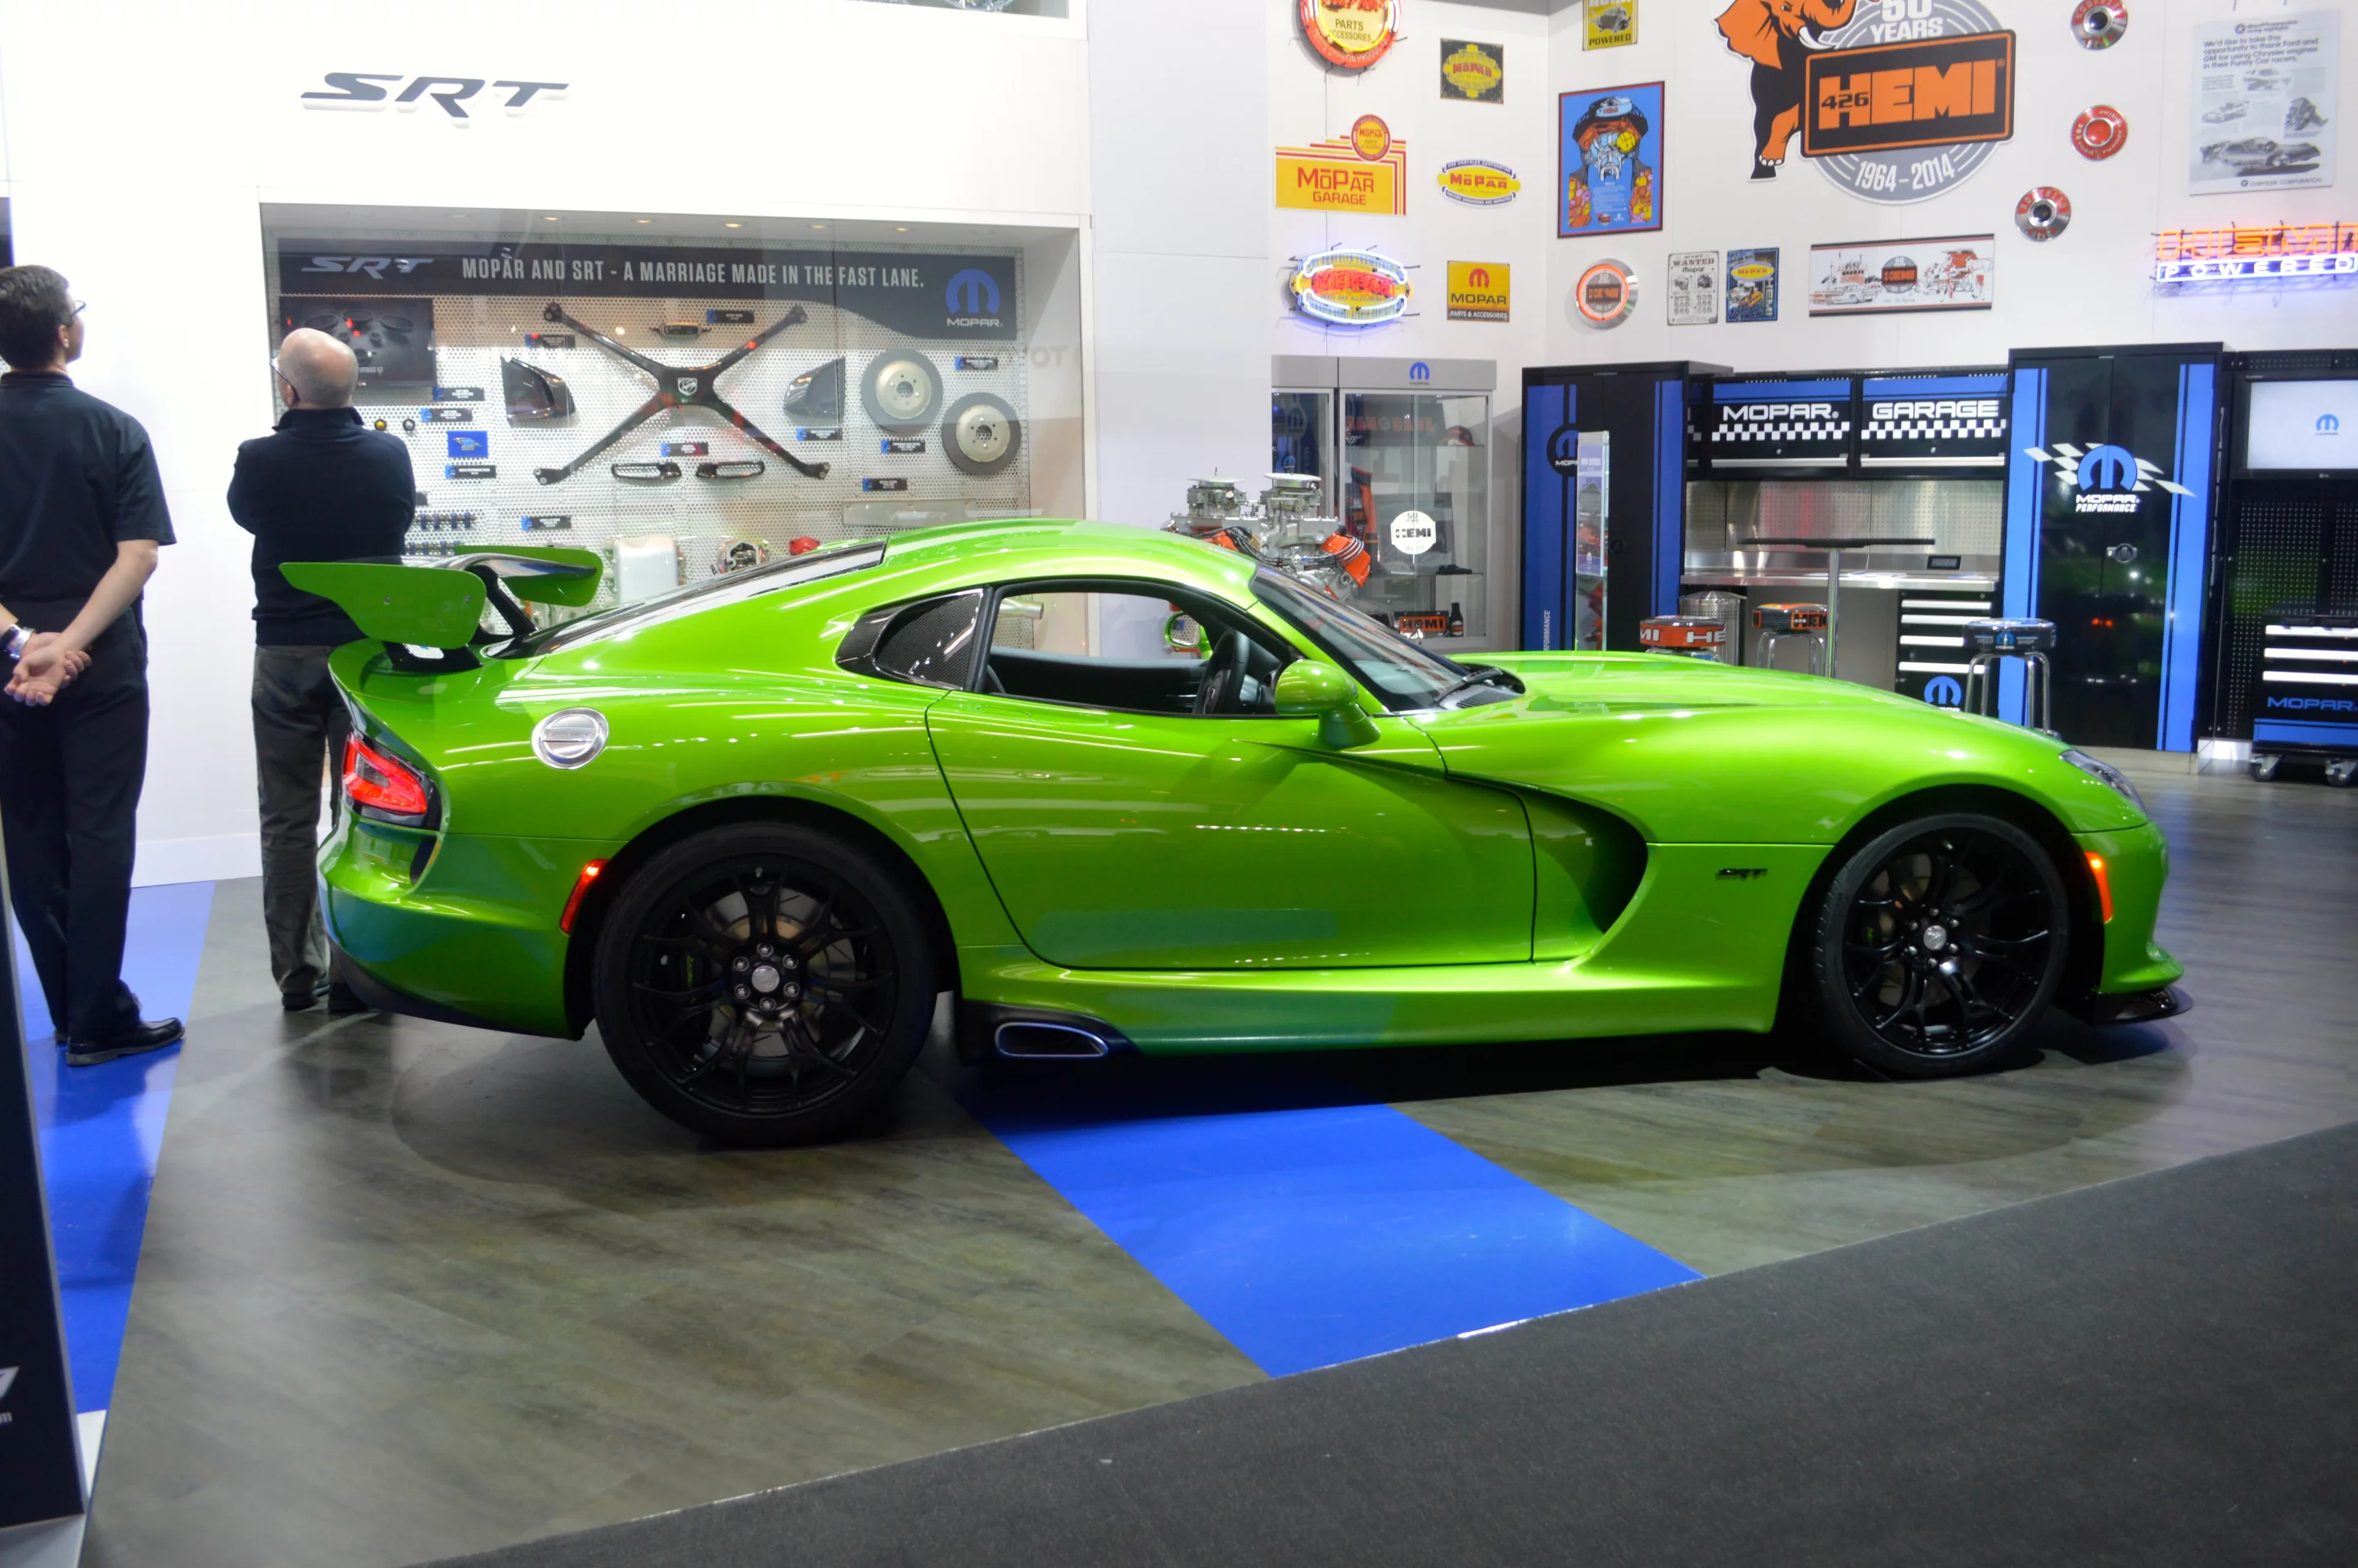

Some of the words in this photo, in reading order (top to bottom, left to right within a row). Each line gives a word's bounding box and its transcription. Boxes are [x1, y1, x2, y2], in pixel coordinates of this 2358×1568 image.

[1882, 0, 1931, 21] 50
[1335, 18, 1364, 31] PARTS
[1870, 17, 1944, 43] YEARS
[1588, 34, 1631, 46] POWERED
[2203, 43, 2248, 55] opportunity
[2230, 52, 2251, 61] using
[2252, 49, 2284, 59] Chrysler
[2287, 47, 2318, 56] engines
[2230, 60, 2253, 68] Funny
[300, 72, 570, 118] SRT
[1818, 59, 1995, 129] HEMI
[1821, 92, 1868, 109] 426
[2279, 177, 2322, 185] CORPORATION
[1313, 192, 1366, 205] GARAGE
[2157, 224, 2358, 260] HEMI
[1673, 258, 1714, 267] WANTED
[2165, 256, 2352, 278] POWERED
[301, 256, 434, 279] SRT
[463, 258, 525, 279] MOPAR
[532, 260, 565, 280] AND
[572, 261, 604, 280] SRT
[624, 262, 634, 281] A
[639, 262, 725, 282] MARRIAGE
[732, 264, 776, 284] MADE
[783, 265, 798, 284] IN
[805, 266, 833, 285] THE
[838, 267, 876, 286] FAST
[883, 268, 924, 287] LANE.
[1451, 293, 1506, 305] MOPAR
[1765, 278, 1773, 316] HEMI
[1450, 310, 1466, 318] PARTS
[1473, 311, 1507, 320] ACCESSORIES
[946, 318, 1000, 328] MOPAR
[1723, 404, 1832, 421] MOPAR
[1872, 400, 1999, 419] GARAGE
[2076, 494, 2136, 504] MOPAR
[2076, 503, 2136, 513] PERFORMANCE
[1395, 527, 1432, 538] HEMI
[2267, 696, 2354, 712] MOPAR
